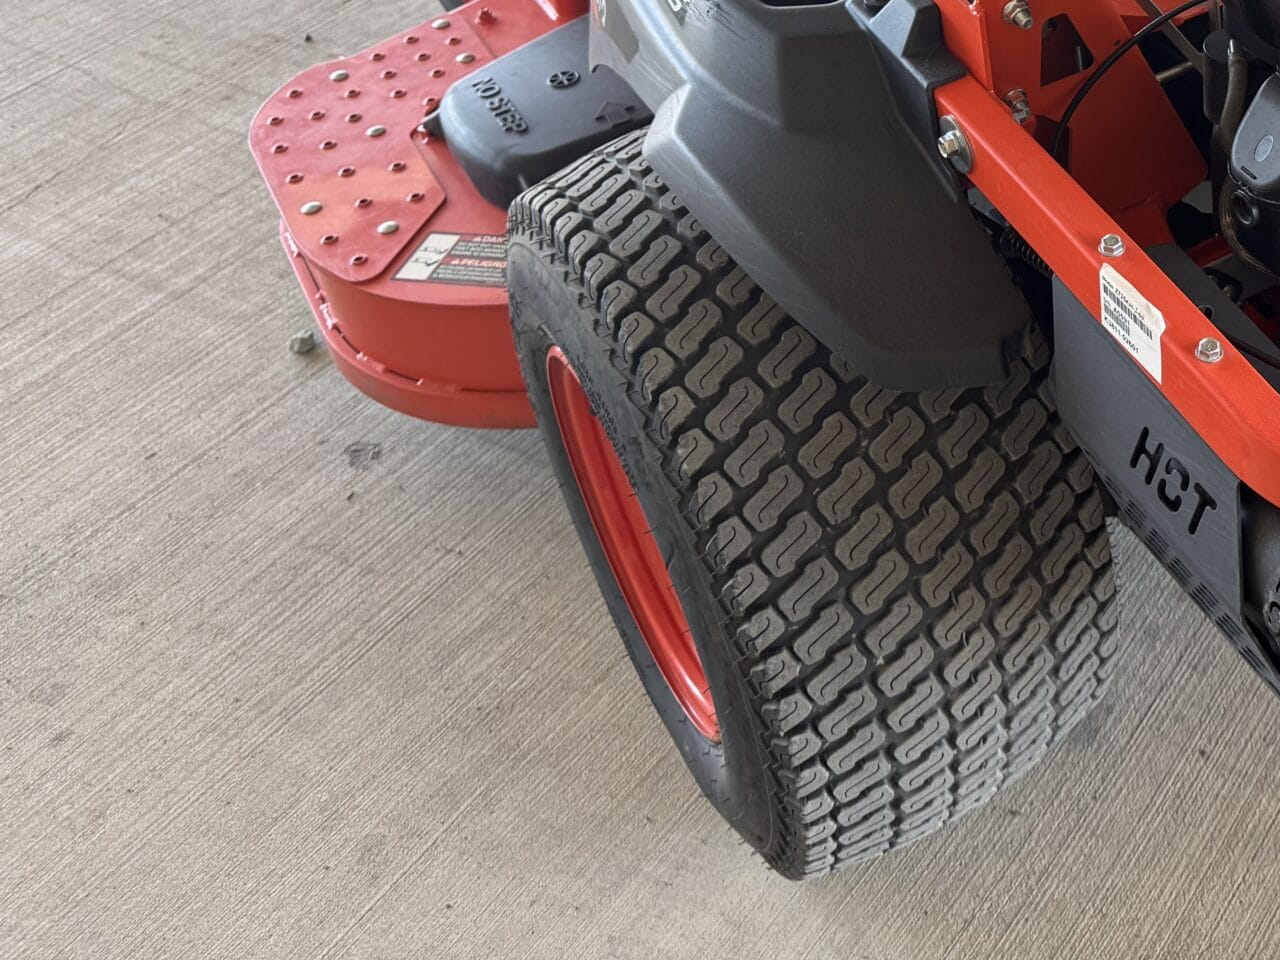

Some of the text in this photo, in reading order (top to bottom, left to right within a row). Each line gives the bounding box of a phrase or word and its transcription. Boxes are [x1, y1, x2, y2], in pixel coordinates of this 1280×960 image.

[471, 76, 529, 133] NO STEP
[1129, 426, 1218, 536] HOT
